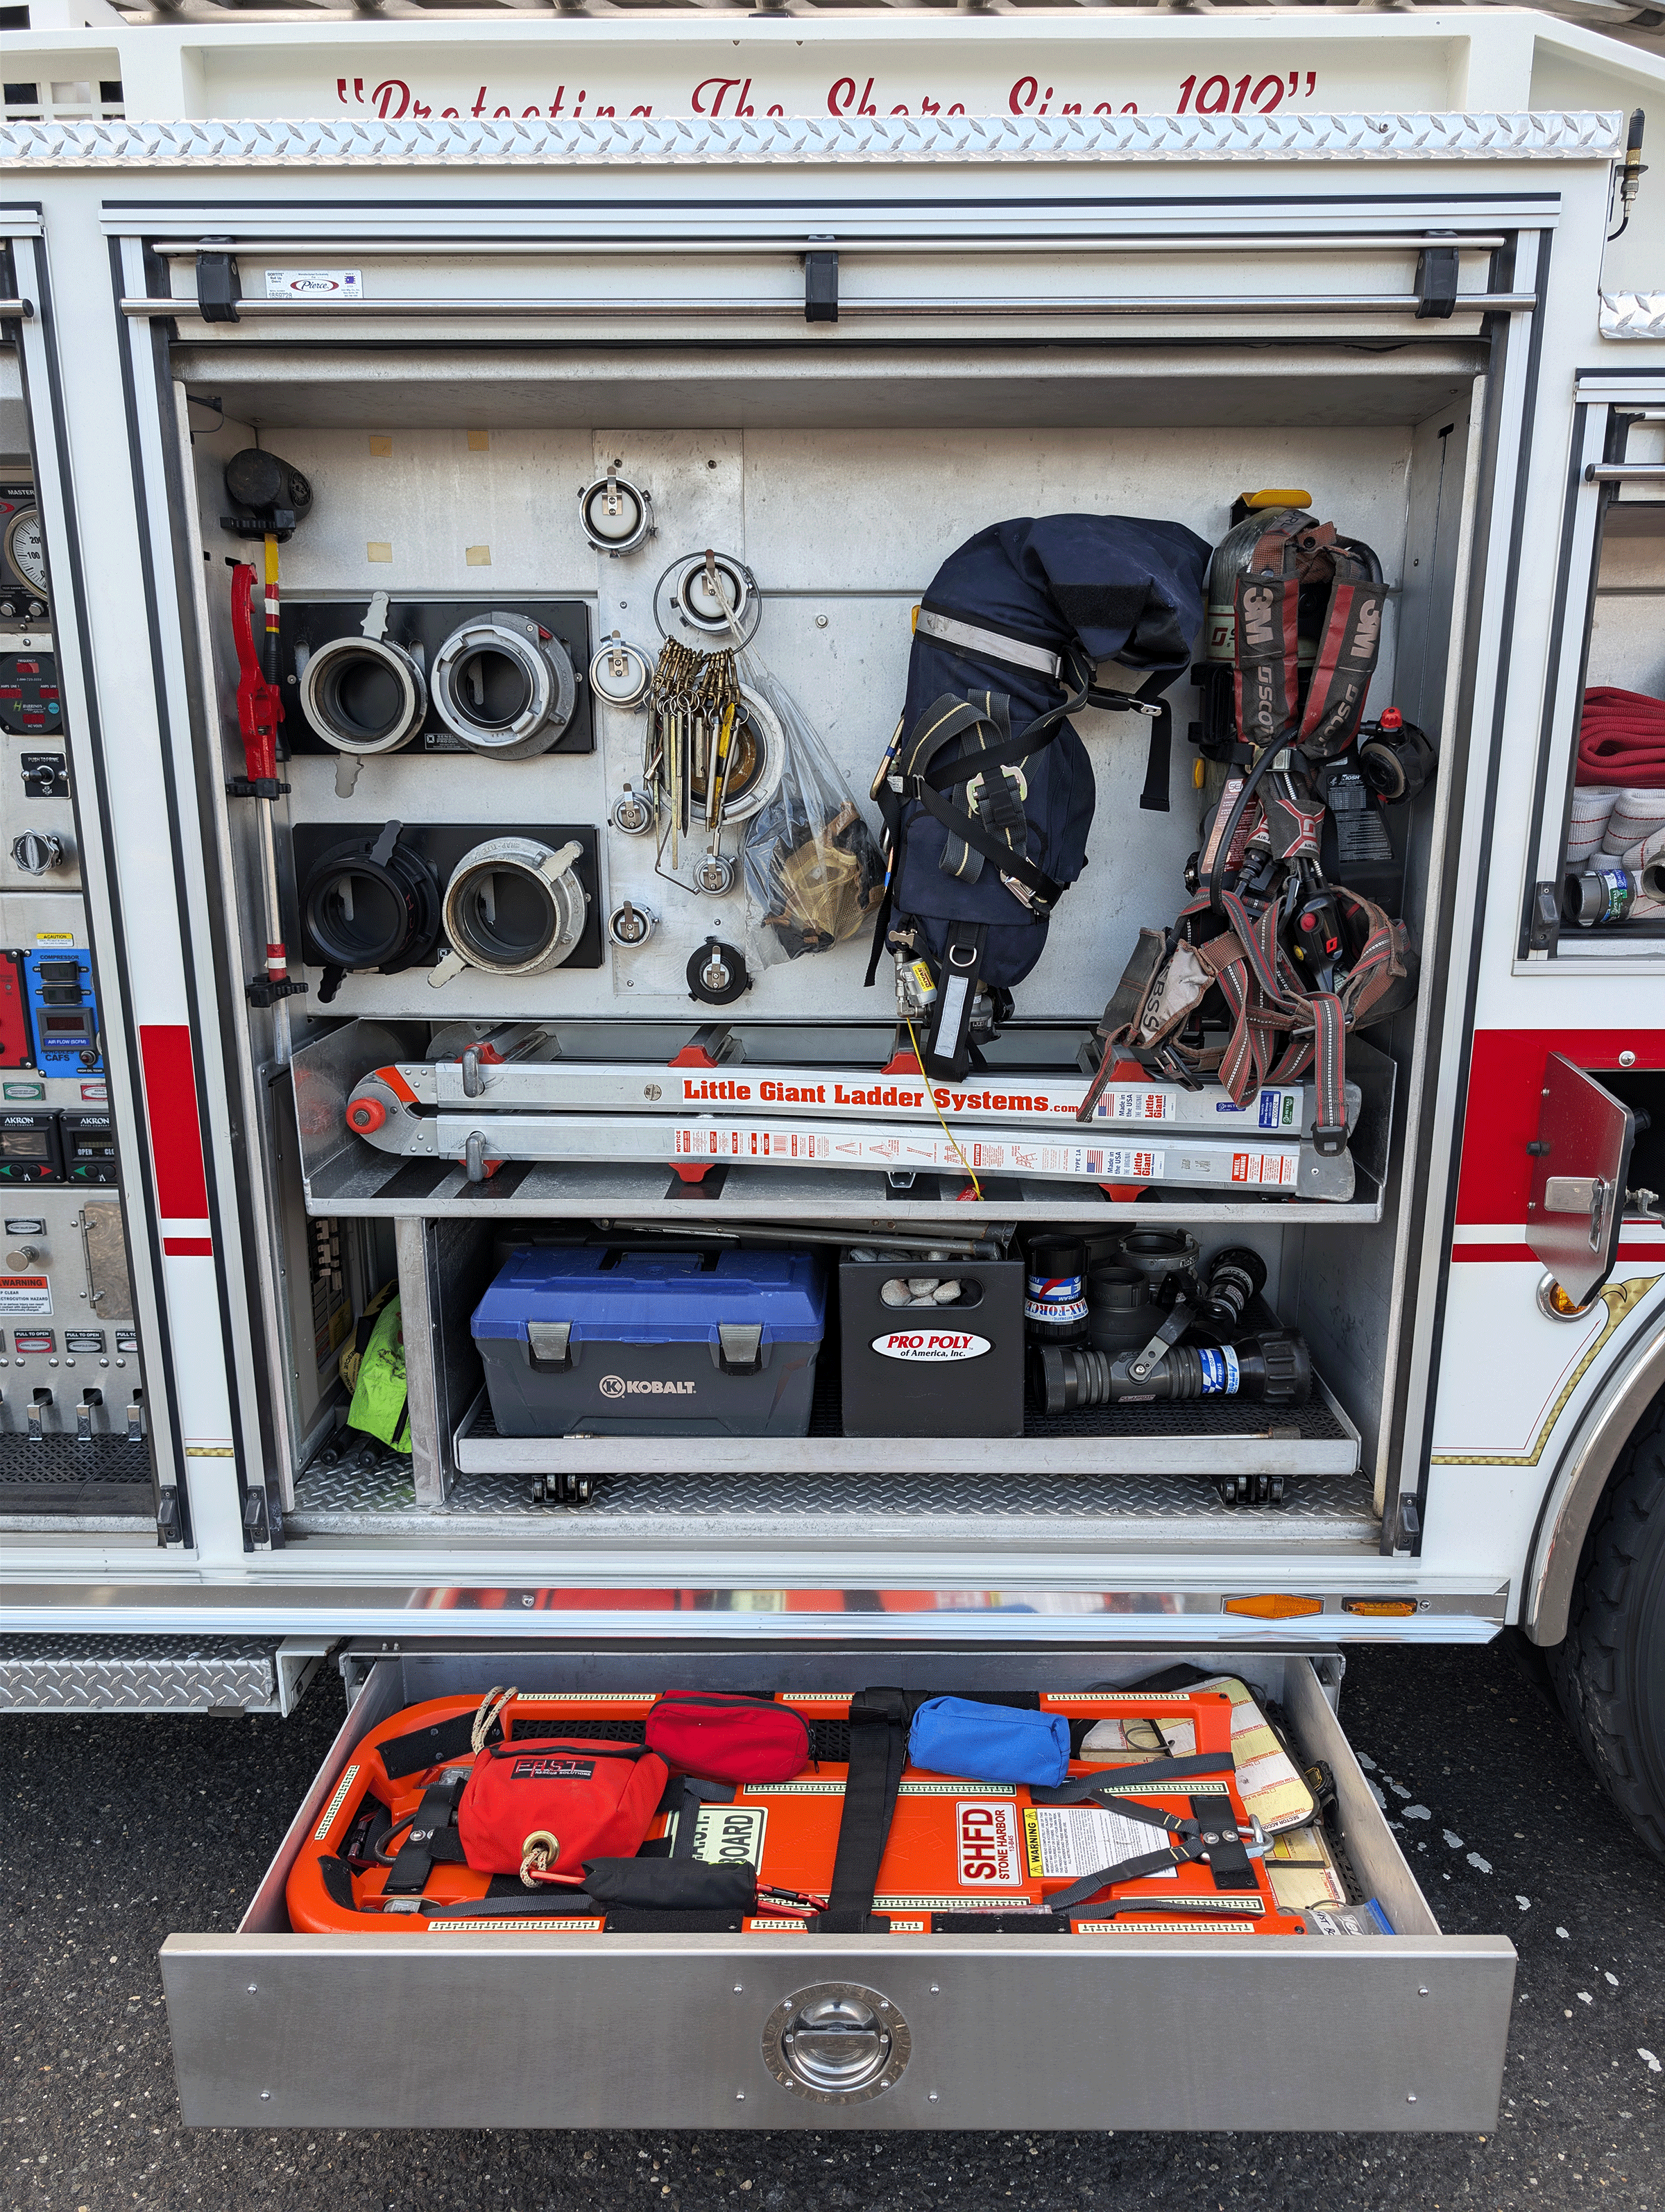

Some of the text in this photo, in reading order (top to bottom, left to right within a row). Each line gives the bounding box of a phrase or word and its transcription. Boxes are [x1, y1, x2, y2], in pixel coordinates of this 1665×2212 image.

[301, 280, 328, 289] Pierce
[1243, 587, 1274, 645] 3M
[1351, 599, 1381, 658] 3M
[683, 1080, 751, 1100] Little
[760, 1084, 826, 1105] Giant
[833, 1084, 925, 1108] Ladder
[1145, 1095, 1154, 1118] Little
[1154, 1095, 1162, 1118] Giant
[1134, 1152, 1143, 1175] Little
[1142, 1153, 1151, 1176] Giant
[887, 1336, 973, 1349] PRO POLY
[627, 1381, 695, 1394] KOBALT
[515, 1760, 584, 1777] FAST
[1262, 1815, 1300, 1830] SECTOR ACCOU
[962, 1808, 997, 1880] SHFD
[995, 1810, 1009, 1880] STONE HARBOR
[1028, 1822, 1040, 1863] WARNING
